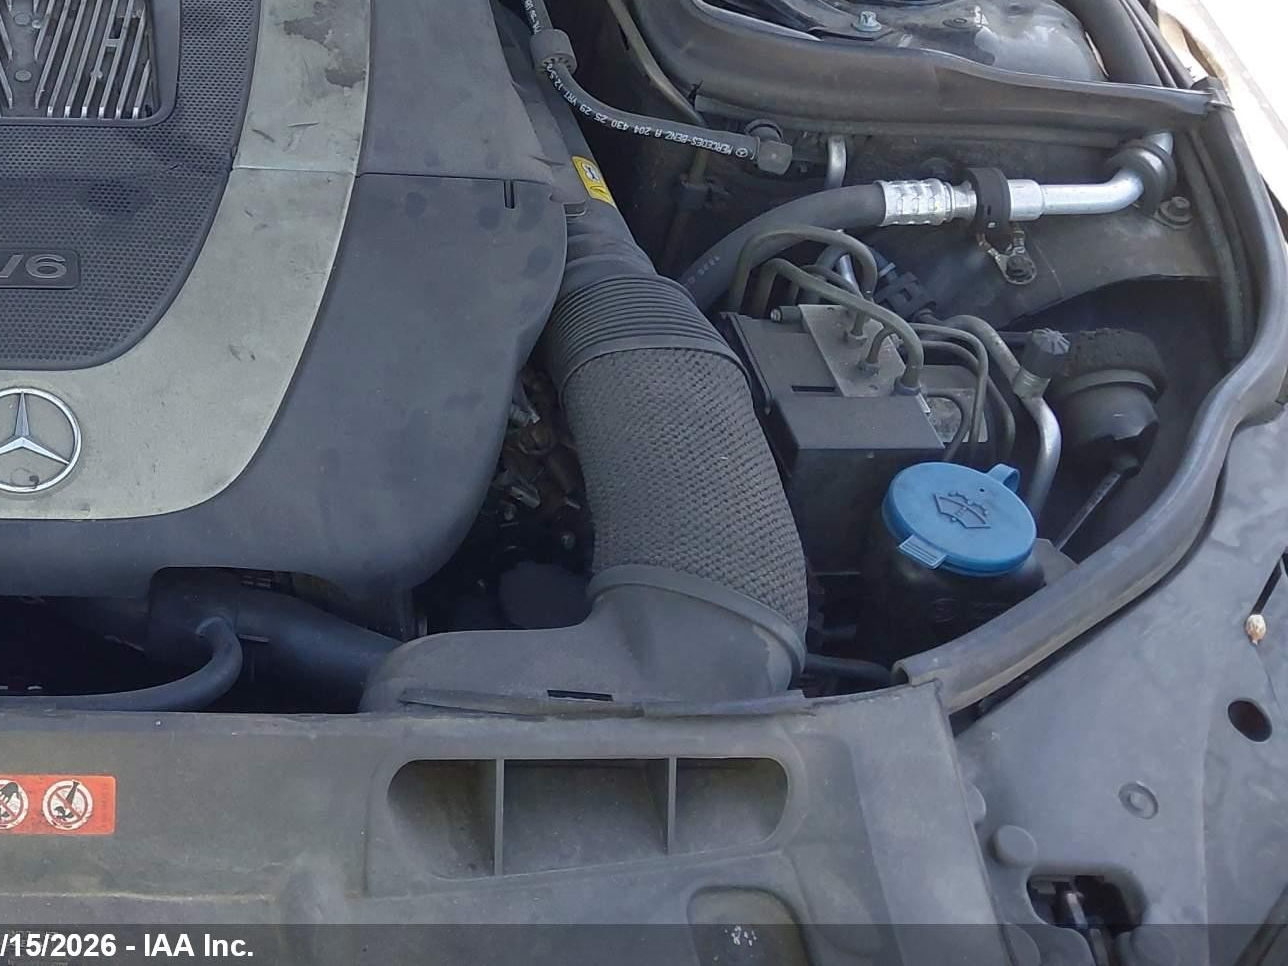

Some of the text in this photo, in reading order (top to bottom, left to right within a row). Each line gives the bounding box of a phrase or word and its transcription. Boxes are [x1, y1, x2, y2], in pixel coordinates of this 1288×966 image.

[579, 104, 592, 115] 29
[594, 112, 609, 124] 25
[611, 119, 629, 131] 430
[633, 125, 652, 136] 204
[665, 130, 733, 155] MERCEDES-BENZ
